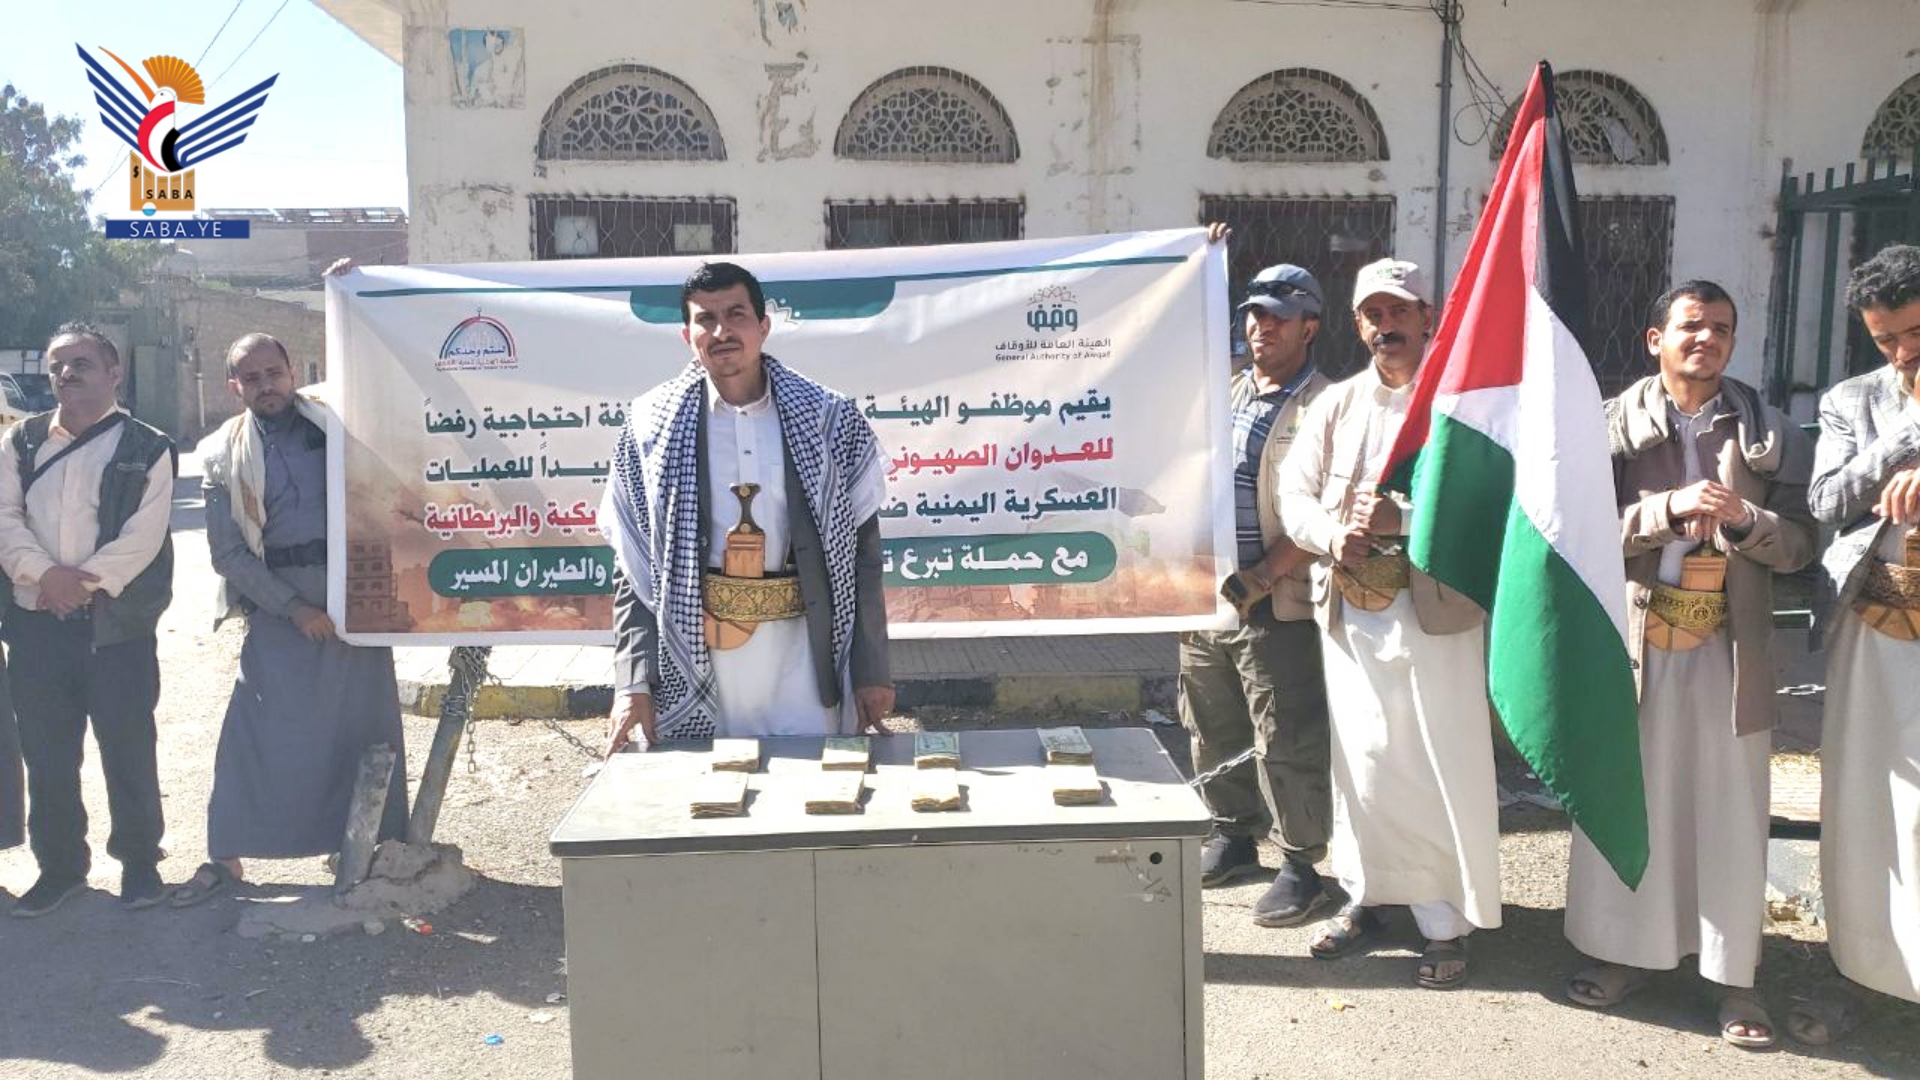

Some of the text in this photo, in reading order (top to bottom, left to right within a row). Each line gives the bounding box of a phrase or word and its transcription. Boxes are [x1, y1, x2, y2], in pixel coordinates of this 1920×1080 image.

[995, 353, 1028, 361] General
[1030, 352, 1070, 361] Authority
[1073, 352, 1081, 360] of
[483, 405, 591, 438] احتجاجية
[864, 394, 950, 426] الهيئة
[957, 392, 1052, 424] موظفو
[1058, 389, 1112, 425] يقيم
[1004, 437, 1115, 471] للعدوان
[425, 455, 534, 487] للعمليات
[916, 491, 996, 524] اليمنية
[1004, 487, 1118, 520] العسكرية
[426, 504, 542, 537] والبريطانية
[514, 557, 607, 589] والطيران
[900, 547, 954, 580] تبرع
[960, 544, 1044, 571] حملة
[1051, 546, 1089, 577] مع
[450, 558, 509, 590] المسير
